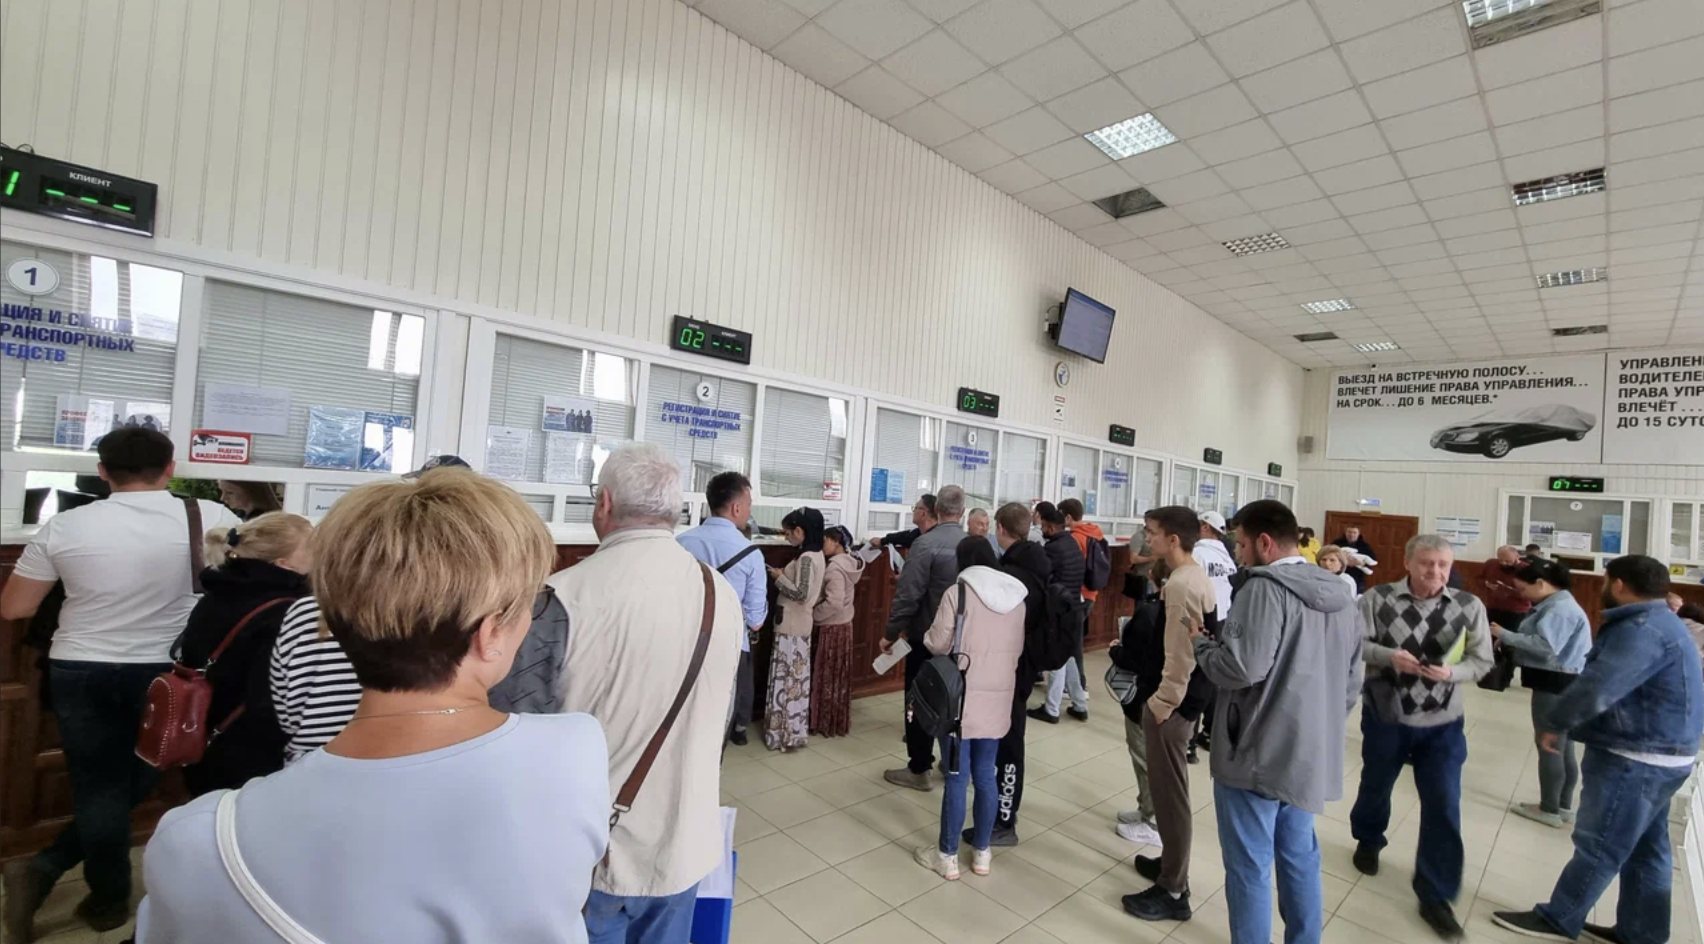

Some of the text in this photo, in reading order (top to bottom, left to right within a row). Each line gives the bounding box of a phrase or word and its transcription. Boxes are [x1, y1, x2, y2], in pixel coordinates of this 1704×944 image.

[69, 171, 112, 187] КЛИЕНТ
[24, 267, 38, 285] 1
[1, 303, 42, 322] ЦИЯ
[48, 309, 62, 325] И
[680, 328, 705, 349] 02
[1619, 355, 1704, 370] УПРАВЛЕН
[1338, 374, 1375, 385] ВЫЕЗД
[1378, 373, 1393, 382] НА
[1396, 368, 1469, 382] ВСТРЕЧНУЮ
[1619, 370, 1704, 385] ВОДИТЕЛЕ
[702, 386, 710, 397] 2
[1337, 386, 1377, 396] ВЛЕЧЕТ
[1380, 383, 1436, 395] ЛИШЕНИЕ
[1439, 381, 1480, 392] ПРАВА
[1618, 385, 1704, 398] ПРАВА УПР
[663, 402, 710, 416] РЕГИСТРАЦИЯ
[963, 395, 976, 409] 03
[1337, 399, 1351, 408] НА
[1397, 396, 1414, 407] ДО
[1417, 396, 1424, 406] 6
[1617, 399, 1678, 413] ВЛЕЧЁТ
[662, 413, 667, 422] С
[668, 414, 690, 425] УЧЕТА
[1616, 416, 1639, 429] ДО
[1643, 416, 1662, 427] 15
[689, 428, 718, 439] СРЕДСТВ
[1553, 480, 1570, 489] 07
[998, 763, 1016, 821] adidas
